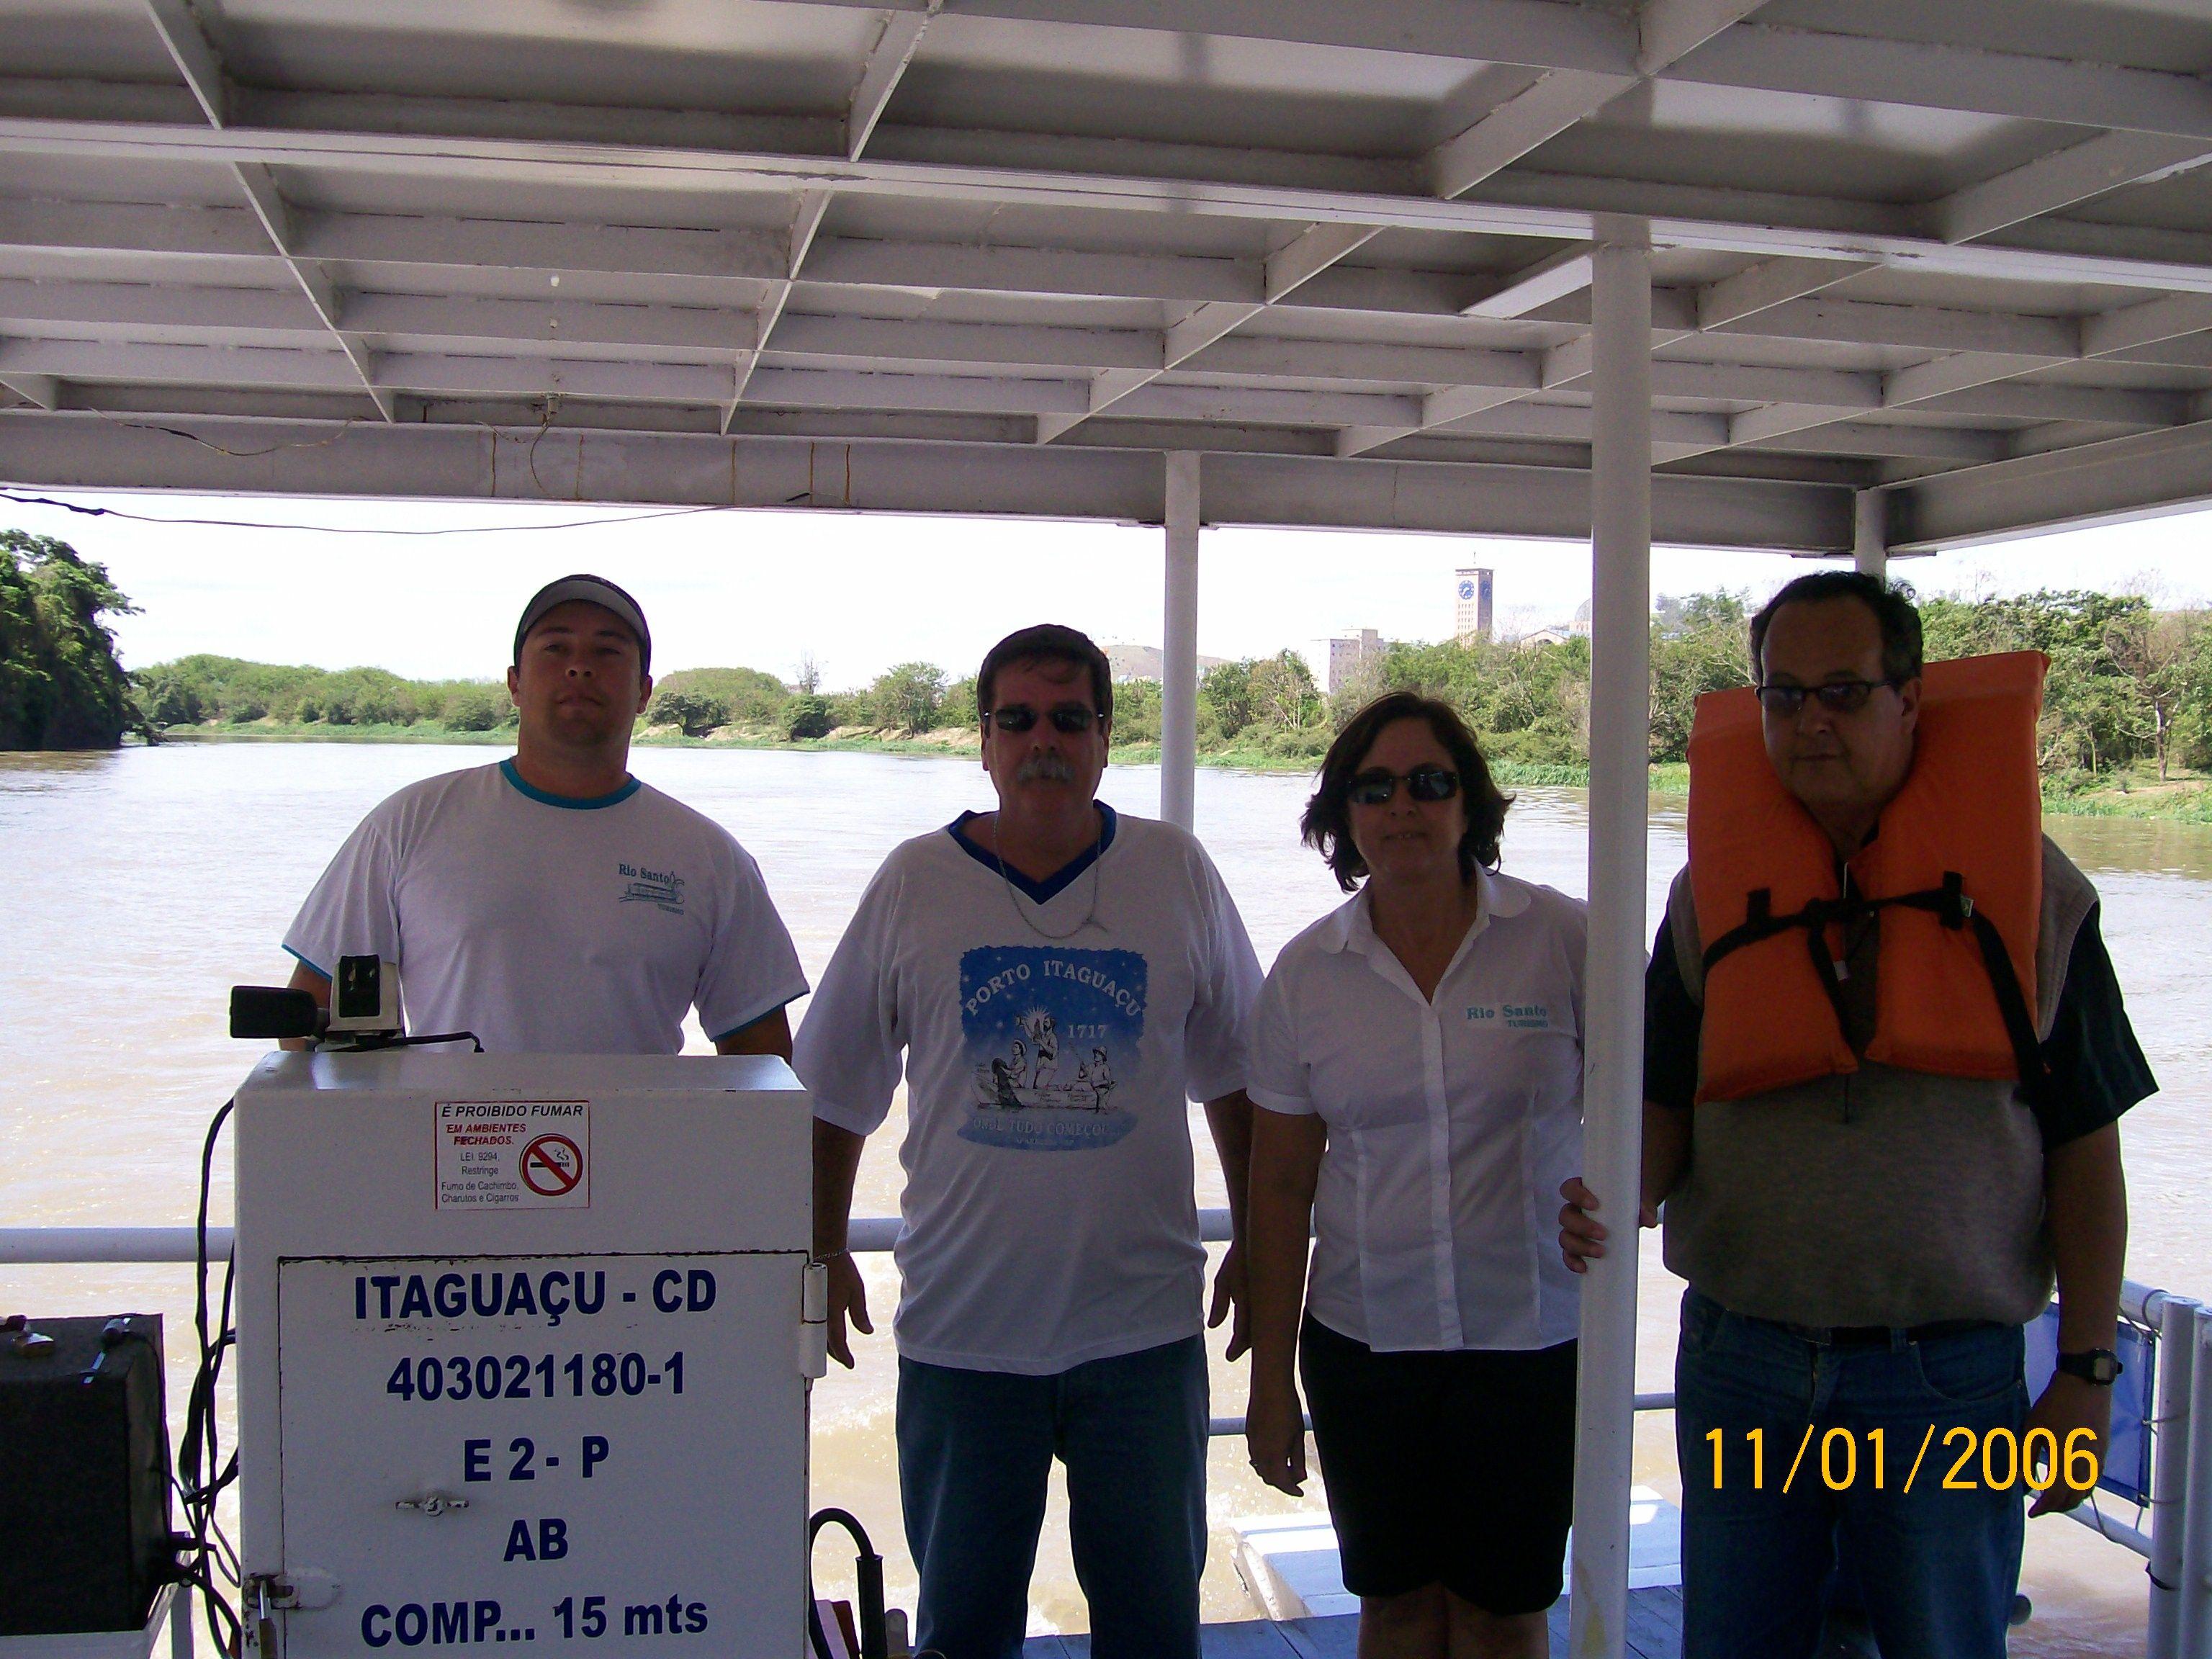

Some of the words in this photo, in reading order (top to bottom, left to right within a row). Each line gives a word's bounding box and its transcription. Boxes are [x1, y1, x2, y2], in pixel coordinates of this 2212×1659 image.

[619, 864, 637, 876] Rio
[640, 868, 670, 884] Santo
[965, 963, 1031, 1016] PORTO
[1043, 960, 1142, 1017] ITAGUAÇU
[1467, 1007, 1495, 1020] Rio
[1502, 1004, 1547, 1017] Santo
[1068, 1024, 1110, 1039] 1717
[441, 1103, 452, 1118] É
[455, 1105, 527, 1117] PROIBIDO
[531, 1105, 584, 1117] FUMAR
[446, 1124, 463, 1133] EM
[465, 1123, 527, 1133] AMBIENTES
[454, 1136, 515, 1146] FECHADOS.
[462, 1166, 499, 1177] Restringe
[441, 1182, 464, 1191] Fumo
[466, 1182, 476, 1190] de
[441, 1194, 477, 1203] Charutos
[486, 1193, 520, 1204] Cigarros
[355, 1271, 606, 1326] ITAGUAÇU
[652, 1269, 716, 1313] CD
[387, 1352, 684, 1401] 403021180-1
[464, 1439, 492, 1483] E
[582, 1435, 609, 1478] P
[503, 1518, 569, 1563] AB
[361, 1600, 535, 1648] COMP...
[552, 1596, 608, 1640] 15
[624, 1593, 709, 1636] mts
